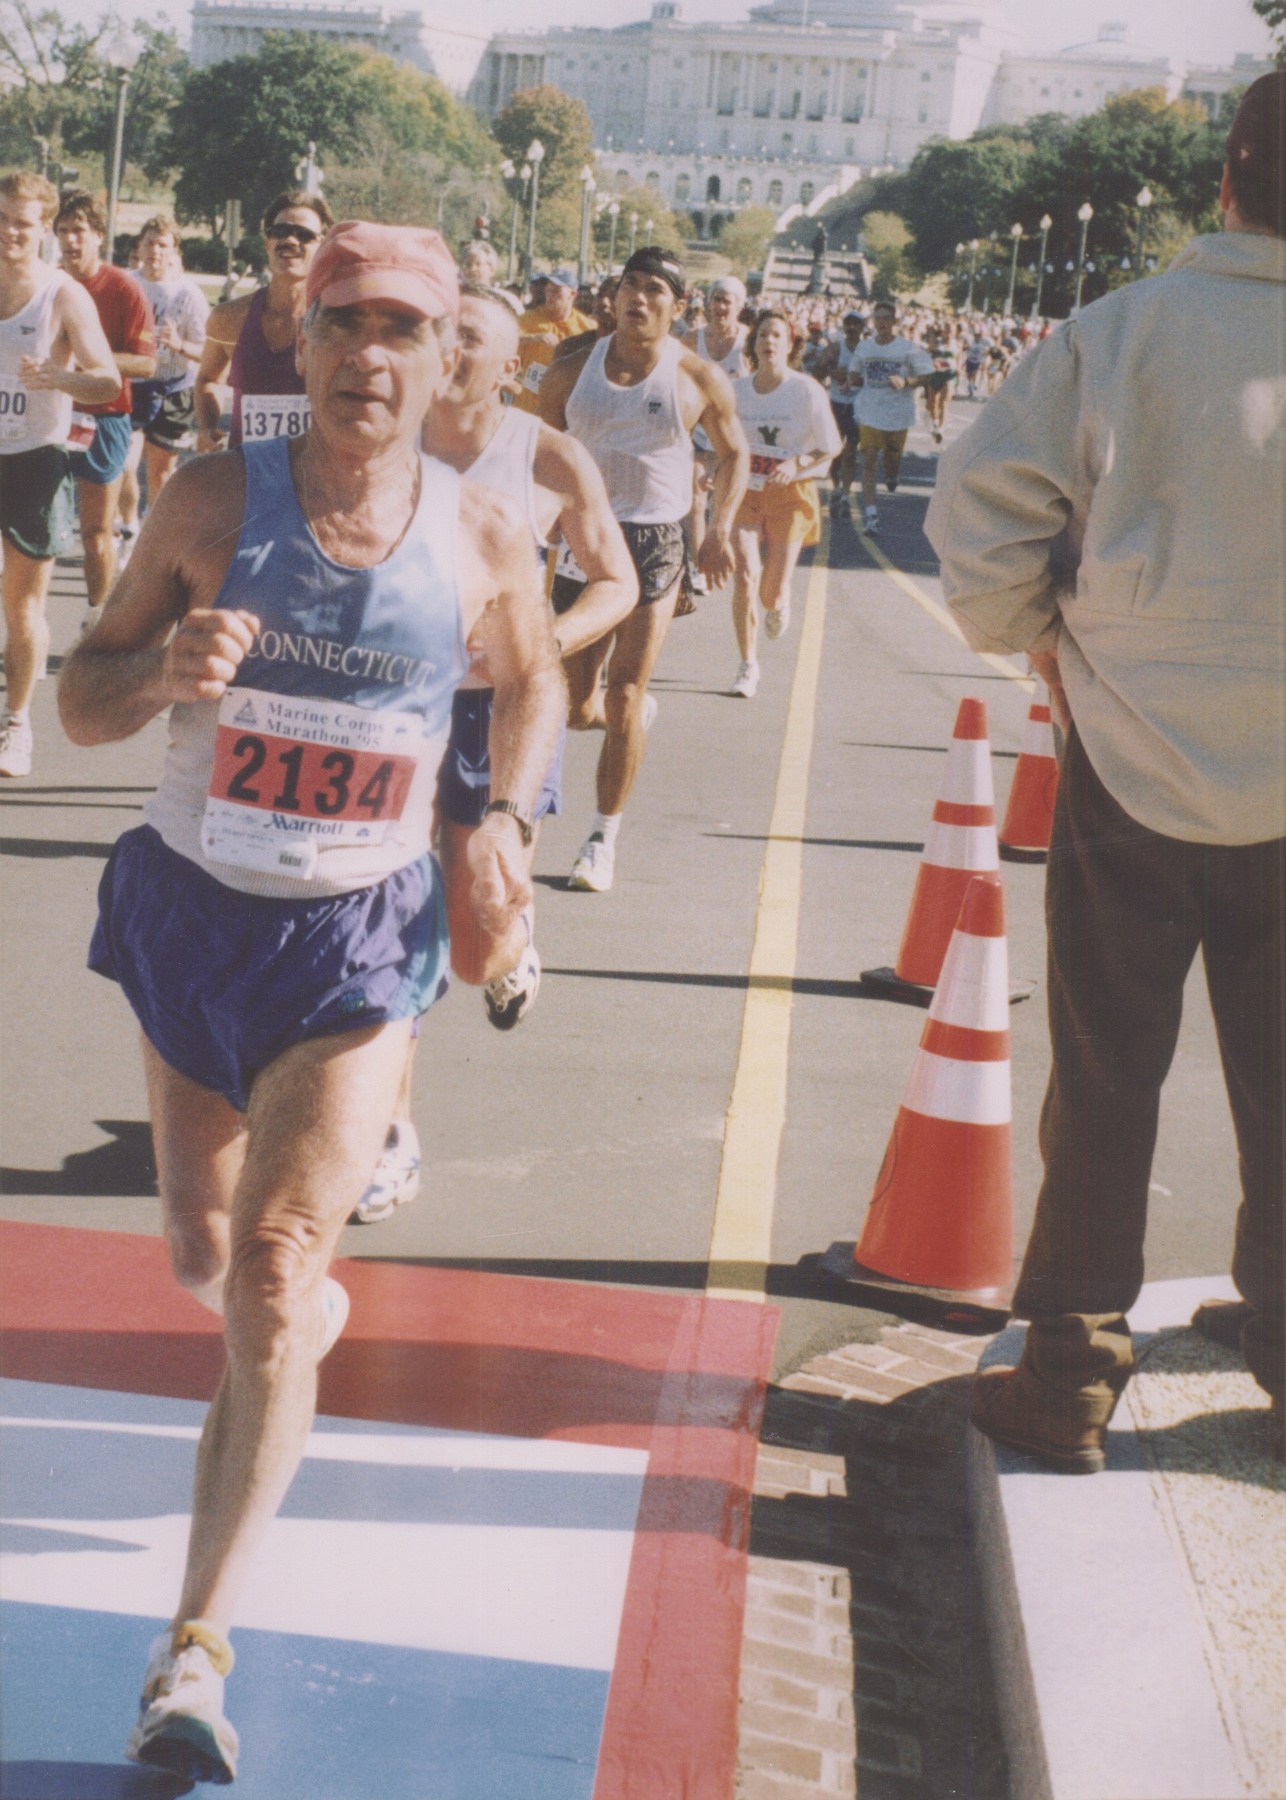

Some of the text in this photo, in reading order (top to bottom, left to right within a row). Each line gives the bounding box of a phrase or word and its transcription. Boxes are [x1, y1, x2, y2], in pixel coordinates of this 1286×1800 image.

[265, 718, 350, 746] Marathon
[267, 701, 384, 735] Marine Corps
[226, 735, 396, 819] 2134
[263, 812, 345, 836] Marriott
